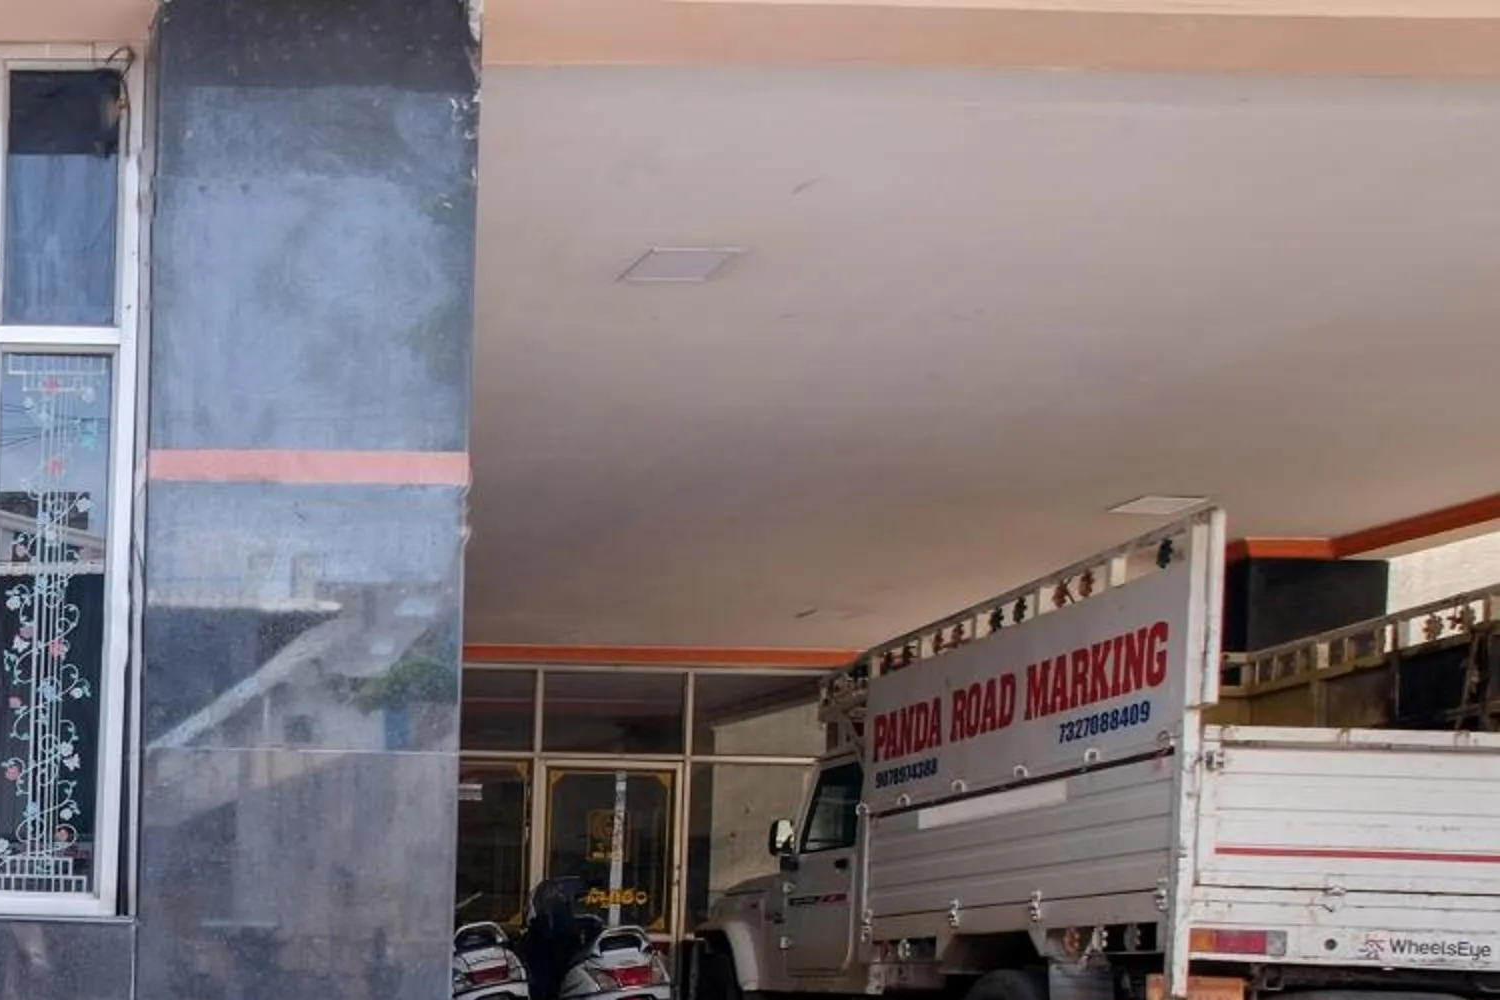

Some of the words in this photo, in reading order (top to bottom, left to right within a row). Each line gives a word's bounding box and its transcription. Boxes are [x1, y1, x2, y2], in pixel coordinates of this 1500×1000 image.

[872, 697, 942, 763] PANDA
[950, 672, 1017, 742] ROAD
[1023, 621, 1170, 721] MARKING
[1058, 700, 1152, 745] 7327088409
[1389, 936, 1492, 961] WheelsEye
